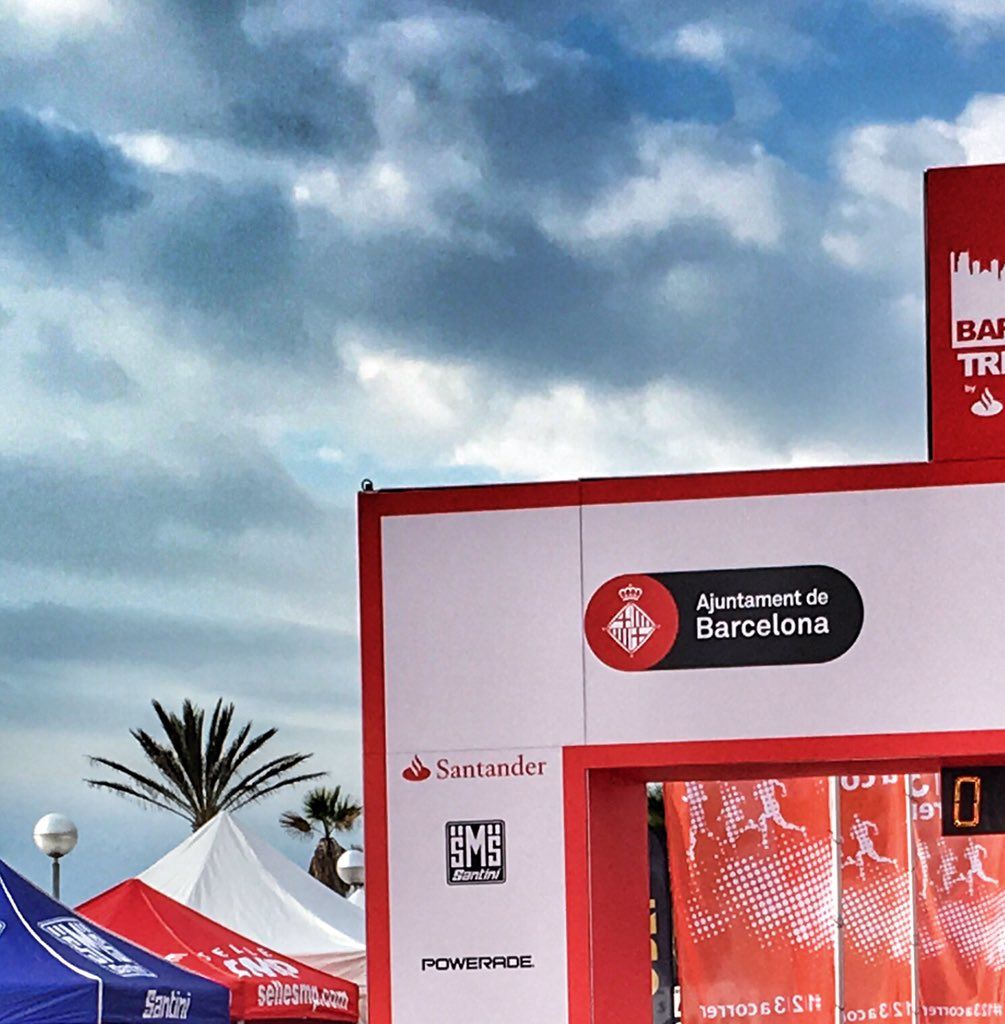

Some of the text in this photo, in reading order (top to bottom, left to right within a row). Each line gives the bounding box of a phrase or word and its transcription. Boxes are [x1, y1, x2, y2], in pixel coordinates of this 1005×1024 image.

[696, 588, 828, 614] Ajuntament de
[696, 613, 829, 639] Barcelona
[436, 754, 547, 779] Santander
[451, 824, 501, 867] SMS
[452, 868, 500, 881] Santini
[422, 956, 533, 971] POWERADE
[142, 990, 191, 1019] Santini
[257, 981, 349, 1012] sellesmp.com
